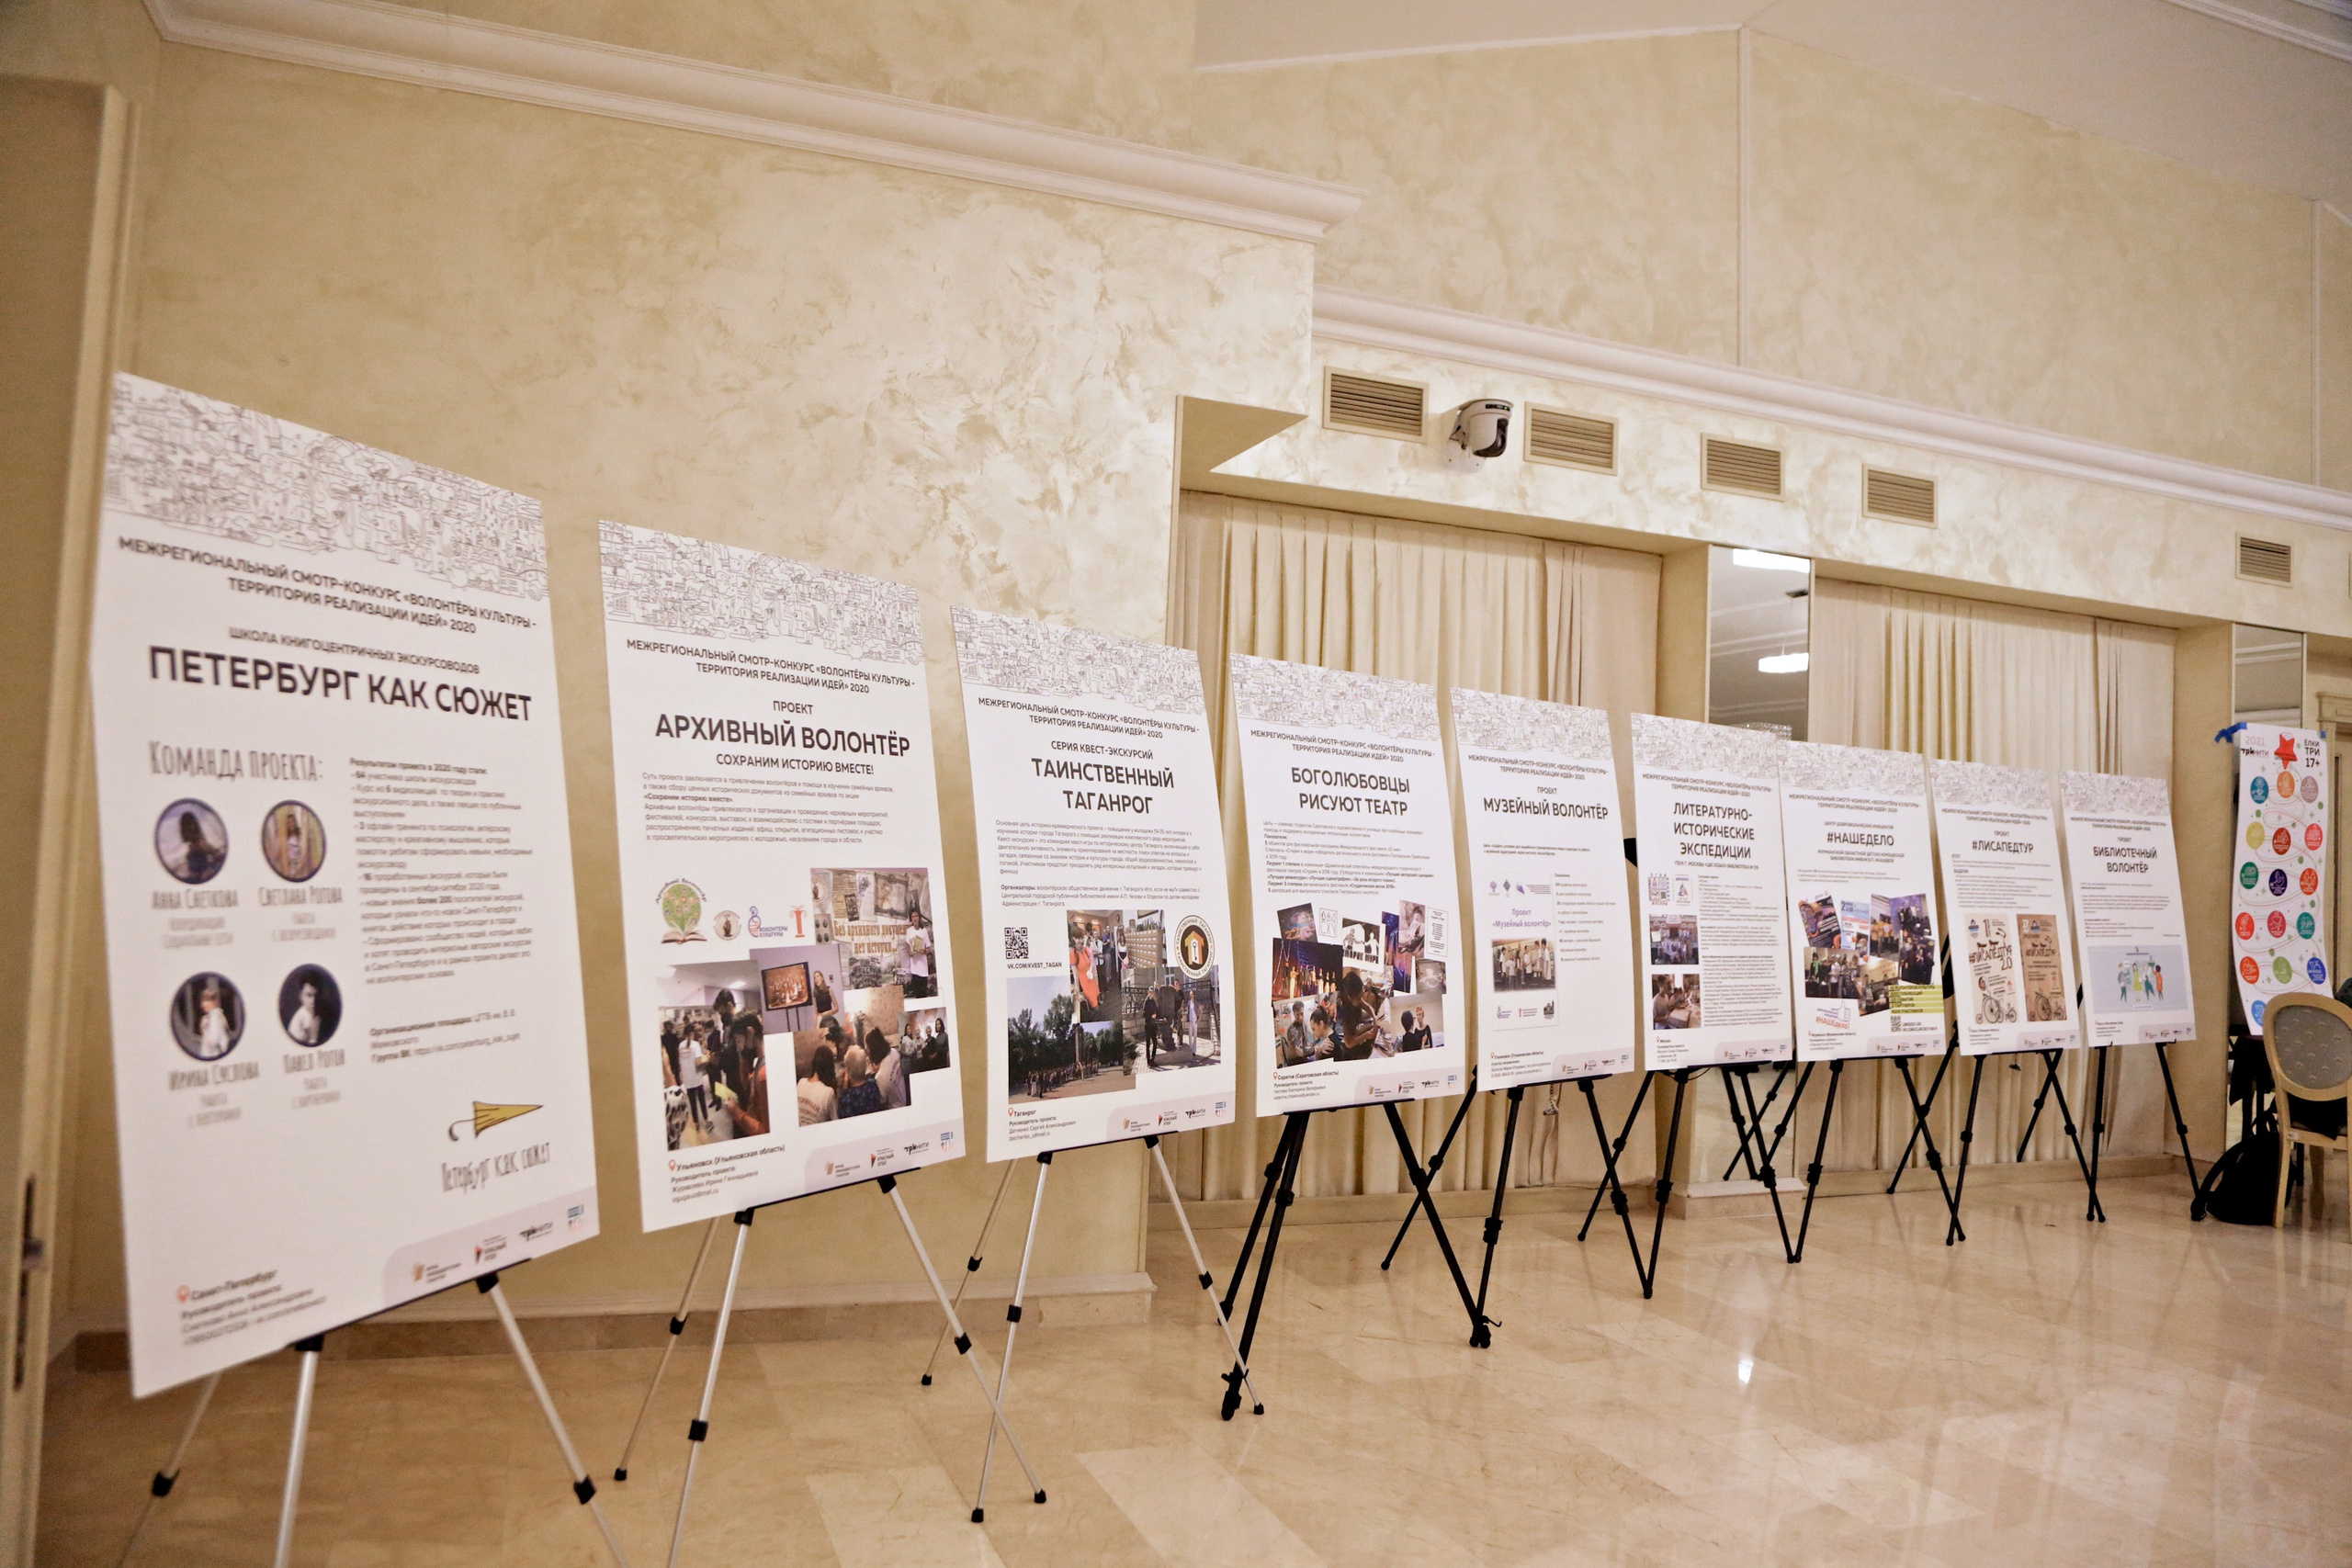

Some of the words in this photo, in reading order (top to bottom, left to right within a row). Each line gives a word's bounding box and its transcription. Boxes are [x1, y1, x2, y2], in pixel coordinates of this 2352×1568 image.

[229, 578, 321, 604] ТЕРРИТОРИЯ
[324, 595, 408, 620] РЕАЛИЗАЦИИ
[412, 613, 447, 626] ИДЕЙ»
[450, 619, 476, 634] 2020
[628, 640, 736, 661] МЕЖРЕГИОНАЛЬНЫЙ
[739, 654, 814, 672] СМОТР-КОНКУРС
[817, 666, 870, 681] «ВОЛОНТЁРЫ
[872, 674, 911, 686] КУЛЬТУРЫ
[151, 647, 357, 698] ПЕТЕРБУРГ
[368, 675, 428, 708] КАК
[435, 684, 531, 720] СЮЖЕТ
[696, 662, 758, 678] ТЕРРИТОРИЯ
[761, 671, 820, 686] РЕАЛИЗАЦИИ
[821, 680, 848, 690] ИДЕЙ»
[851, 683, 869, 694] 2020
[774, 701, 813, 714] ПРОЕКТ
[978, 698, 1058, 714] МЕЖРЕГИОНАЛЬНЫЙ
[1060, 708, 1118, 722] СМОТР-КОНКУРС
[1120, 716, 1163, 728] «ВОЛОНТЁРЫ
[1164, 722, 1195, 732] КУЛЬТУРЫ
[657, 715, 795, 746] АРХИВНЫЙ
[802, 728, 910, 756] ВОЛОНТЁР
[1030, 716, 1076, 728] ТЕРРИТОРИЯ
[1078, 721, 1124, 733] РЕАЛИЗАЦИИ
[1125, 728, 1146, 736] ИДЕЙ»
[1148, 730, 1163, 739] 2020
[1051, 740, 1079, 751] СЕРИЯ
[1080, 744, 1153, 759] КВЕСТ-ЭКСКУРСИЙ
[1251, 730, 1317, 742] МЕЖРЕГИОНАЛЬНЫЙ
[1317, 738, 1366, 749] СМОТР-КОНКУРС
[1367, 744, 1404, 753] «ВОЛОНТЁРЫ
[1405, 749, 1432, 757] КУЛЬТУРЫ
[2245, 736, 2266, 746] 2021
[2304, 739, 2320, 747] ЁЛКИ
[1293, 744, 1330, 753] ТЕРРИТОРИЯ
[1332, 749, 1370, 758] РЕАЛИЗАЦИИ
[2305, 747, 2320, 756] ТРИ
[717, 754, 779, 768] СОХРАНИМ
[782, 759, 833, 772] ИСТОРИЮ
[835, 762, 874, 774] ВМЕСТЕ!
[2305, 758, 2320, 768] 17+
[1033, 759, 1173, 787] ТАИНСТВЕННЫЙ
[1292, 768, 1409, 793] БОГОЛЮБОВЦЫ
[1537, 786, 1557, 795] ПРОЕКТ
[1064, 791, 1152, 813] ТАГАНРОГ
[1300, 794, 1362, 812] РИСУЮТ
[1365, 798, 1408, 816] ТЕАТР
[1484, 798, 1550, 815] МУЗЕЙНЫЙ
[1553, 803, 1608, 819] ВОЛОНТЁР
[1674, 803, 1752, 820] ЛИТЕРАТУРНО-
[1674, 823, 1754, 840] ИСТОРИЧЕСКИЕ
[1827, 833, 1894, 846] #НАШЕДЕЛО
[1680, 842, 1750, 859] ЭКСПЕДИЦИИ
[1972, 840, 2034, 854] #ЛИСАПЕДТУР
[2093, 846, 2157, 859] БИБЛИОТЕЧНЫЙ
[2107, 862, 2149, 874] ВОЛОНТЁР
[1511, 908, 1532, 917] Проект
[677, 1160, 713, 1171] Ульяновск
[715, 1151, 758, 1165] (Ульяновская
[759, 1145, 785, 1155] область)
